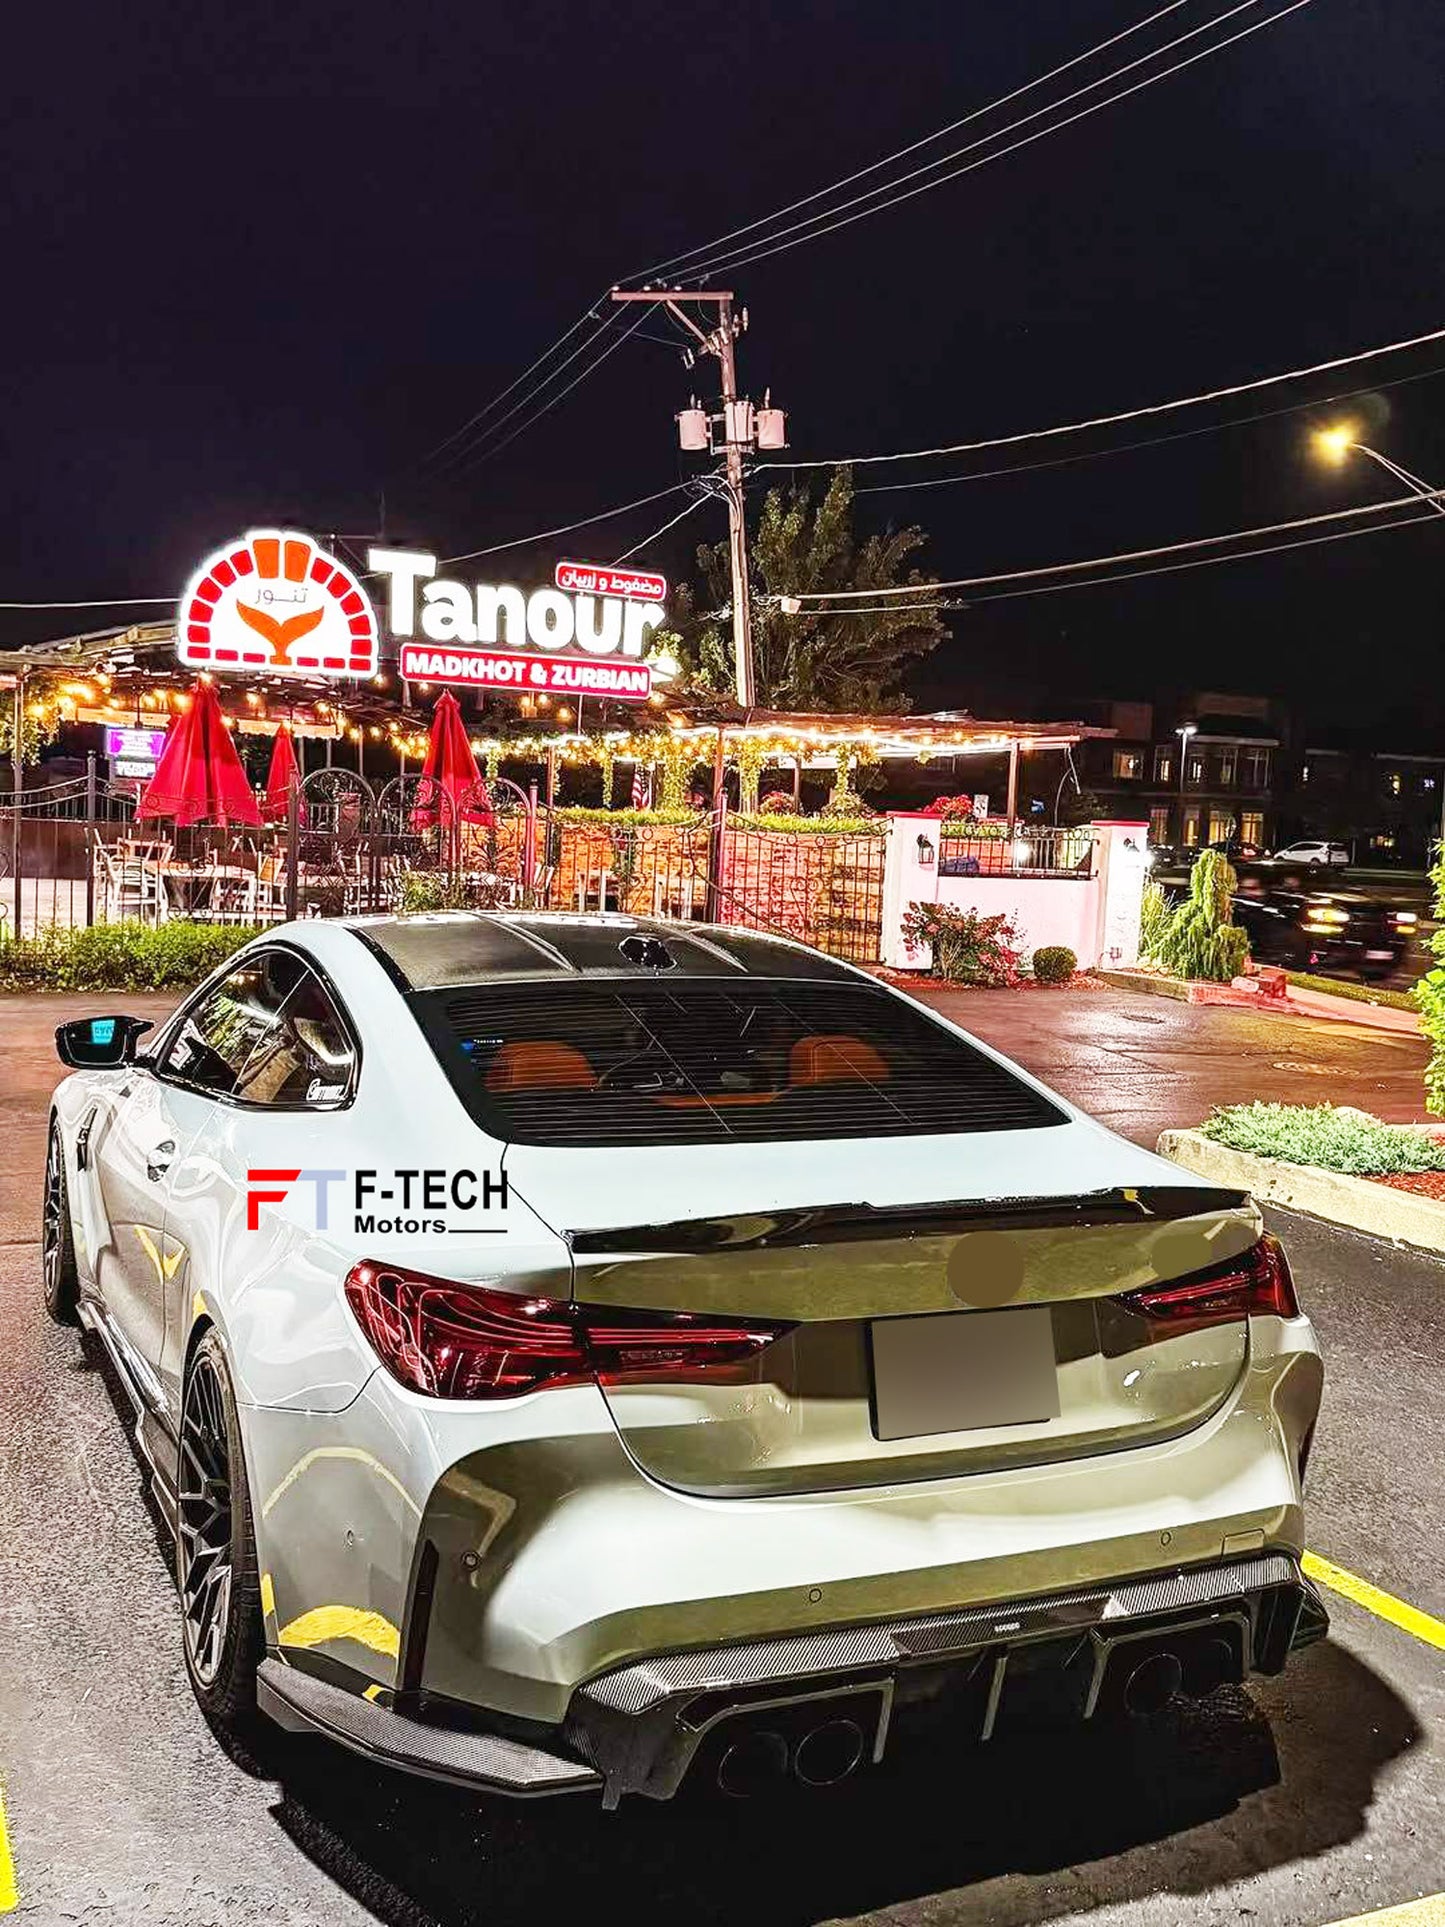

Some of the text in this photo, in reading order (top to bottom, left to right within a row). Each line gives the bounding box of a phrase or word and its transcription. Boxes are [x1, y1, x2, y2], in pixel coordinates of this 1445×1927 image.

[254, 587, 309, 605] تنور
[598, 577, 608, 591] و
[368, 549, 664, 657] Tanour
[406, 652, 648, 692] MADKHOT & ZURBIAN
